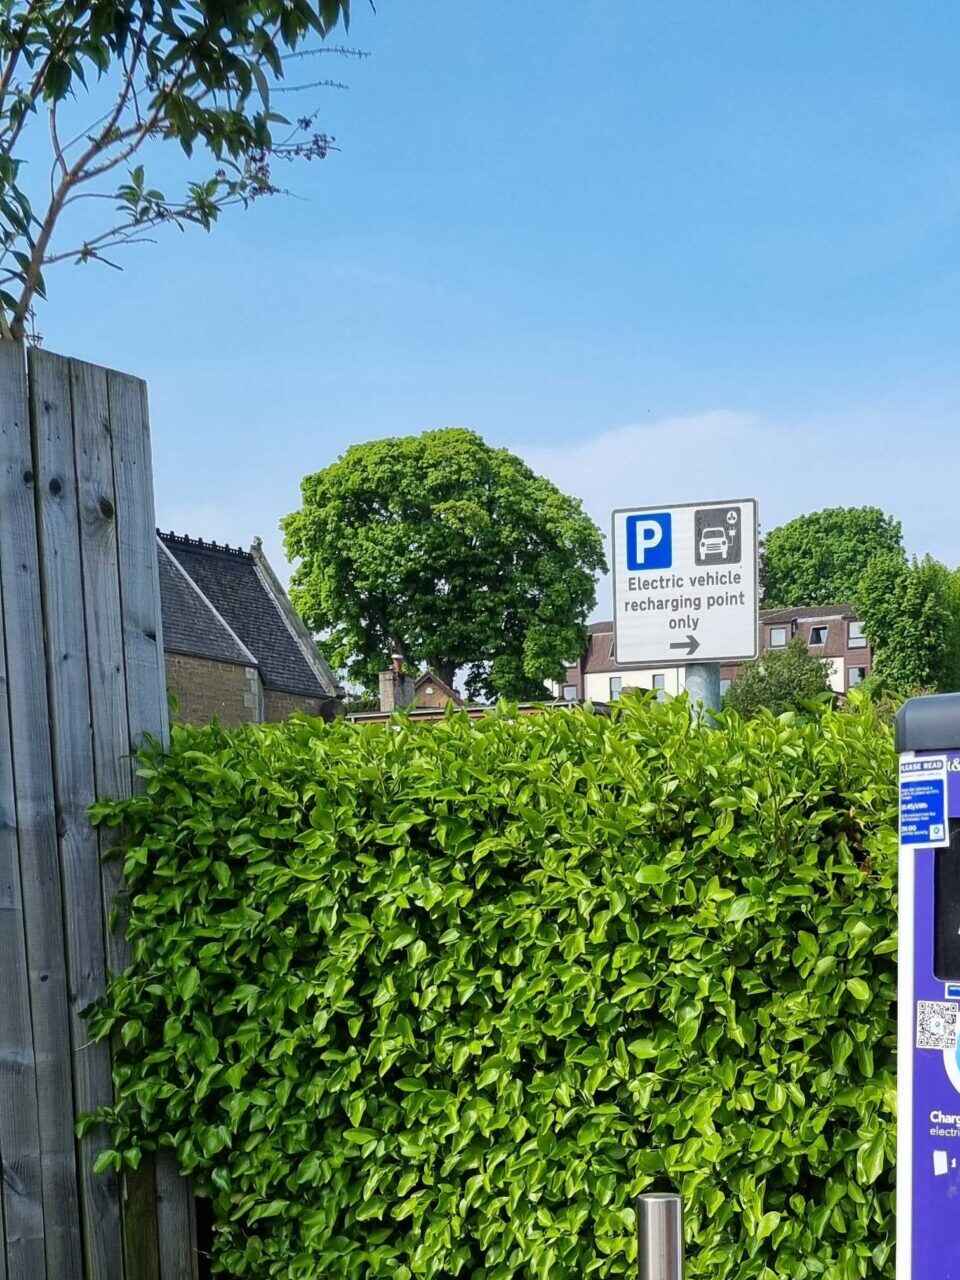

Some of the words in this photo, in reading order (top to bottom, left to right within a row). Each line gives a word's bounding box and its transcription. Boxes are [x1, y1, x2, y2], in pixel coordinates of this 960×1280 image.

[635, 520, 663, 564] P
[628, 575, 684, 591] Electric
[690, 570, 741, 587] vehicle
[624, 595, 701, 612] recharging
[707, 592, 745, 608] point
[668, 614, 700, 631] only
